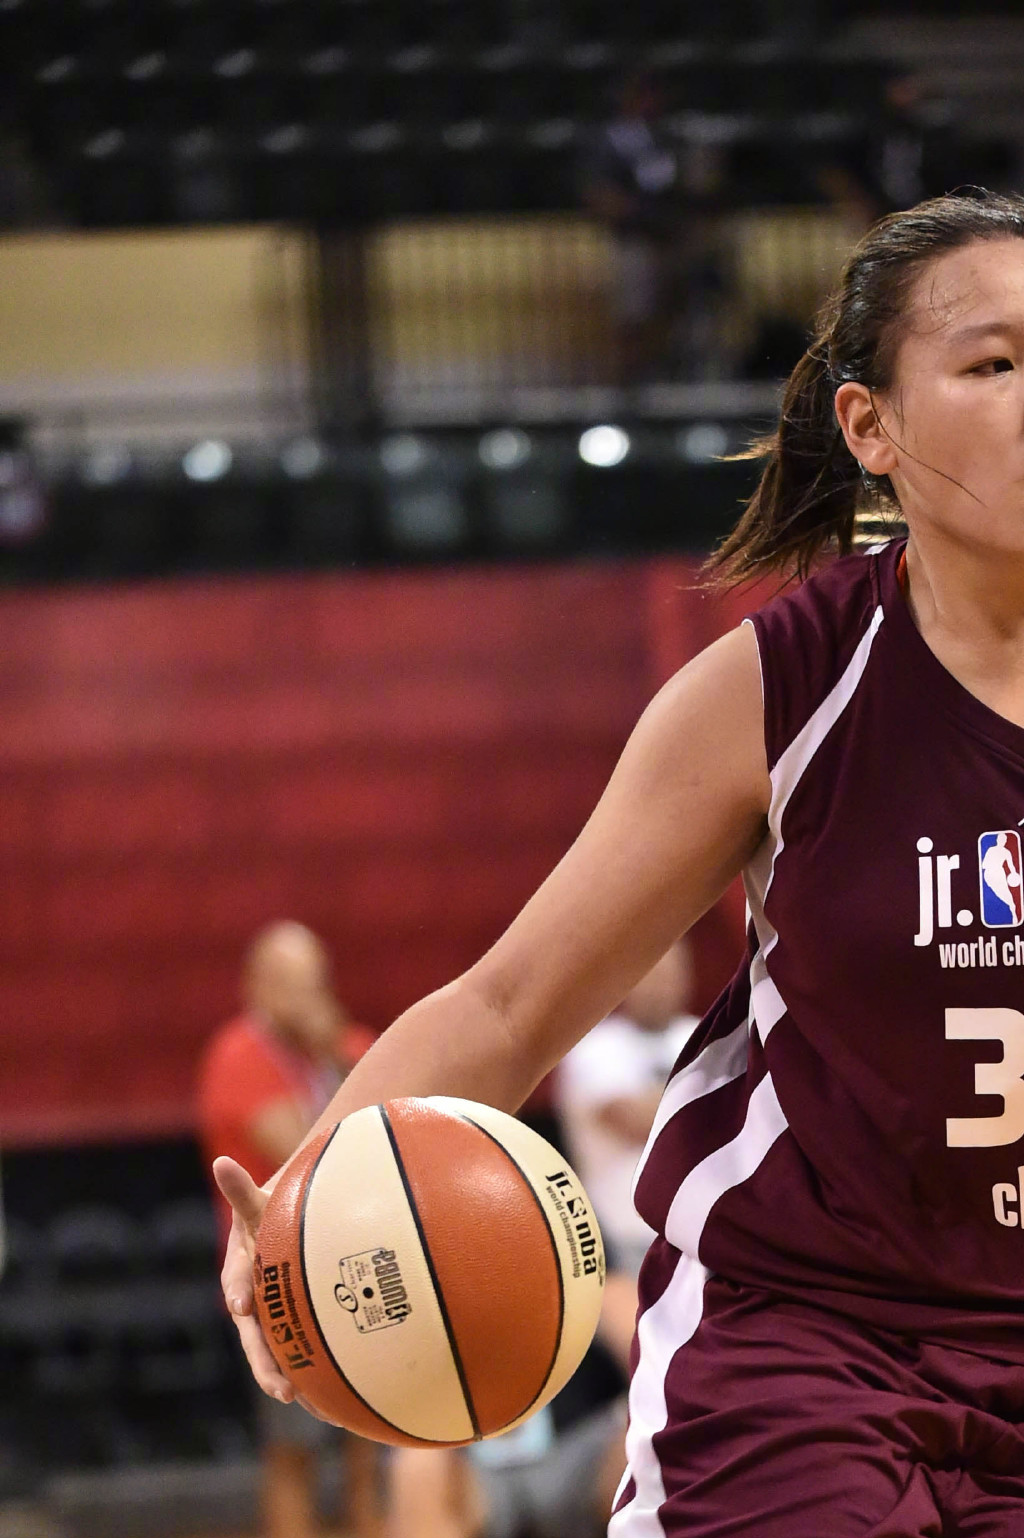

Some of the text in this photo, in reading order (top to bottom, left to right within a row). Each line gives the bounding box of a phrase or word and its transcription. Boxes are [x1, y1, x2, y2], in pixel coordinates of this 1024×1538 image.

[914, 836, 974, 947] jr.
[938, 935, 998, 969] world
[546, 1185, 581, 1279] world championship
[576, 1221, 597, 1275] nba
[263, 1265, 286, 1319] nba
